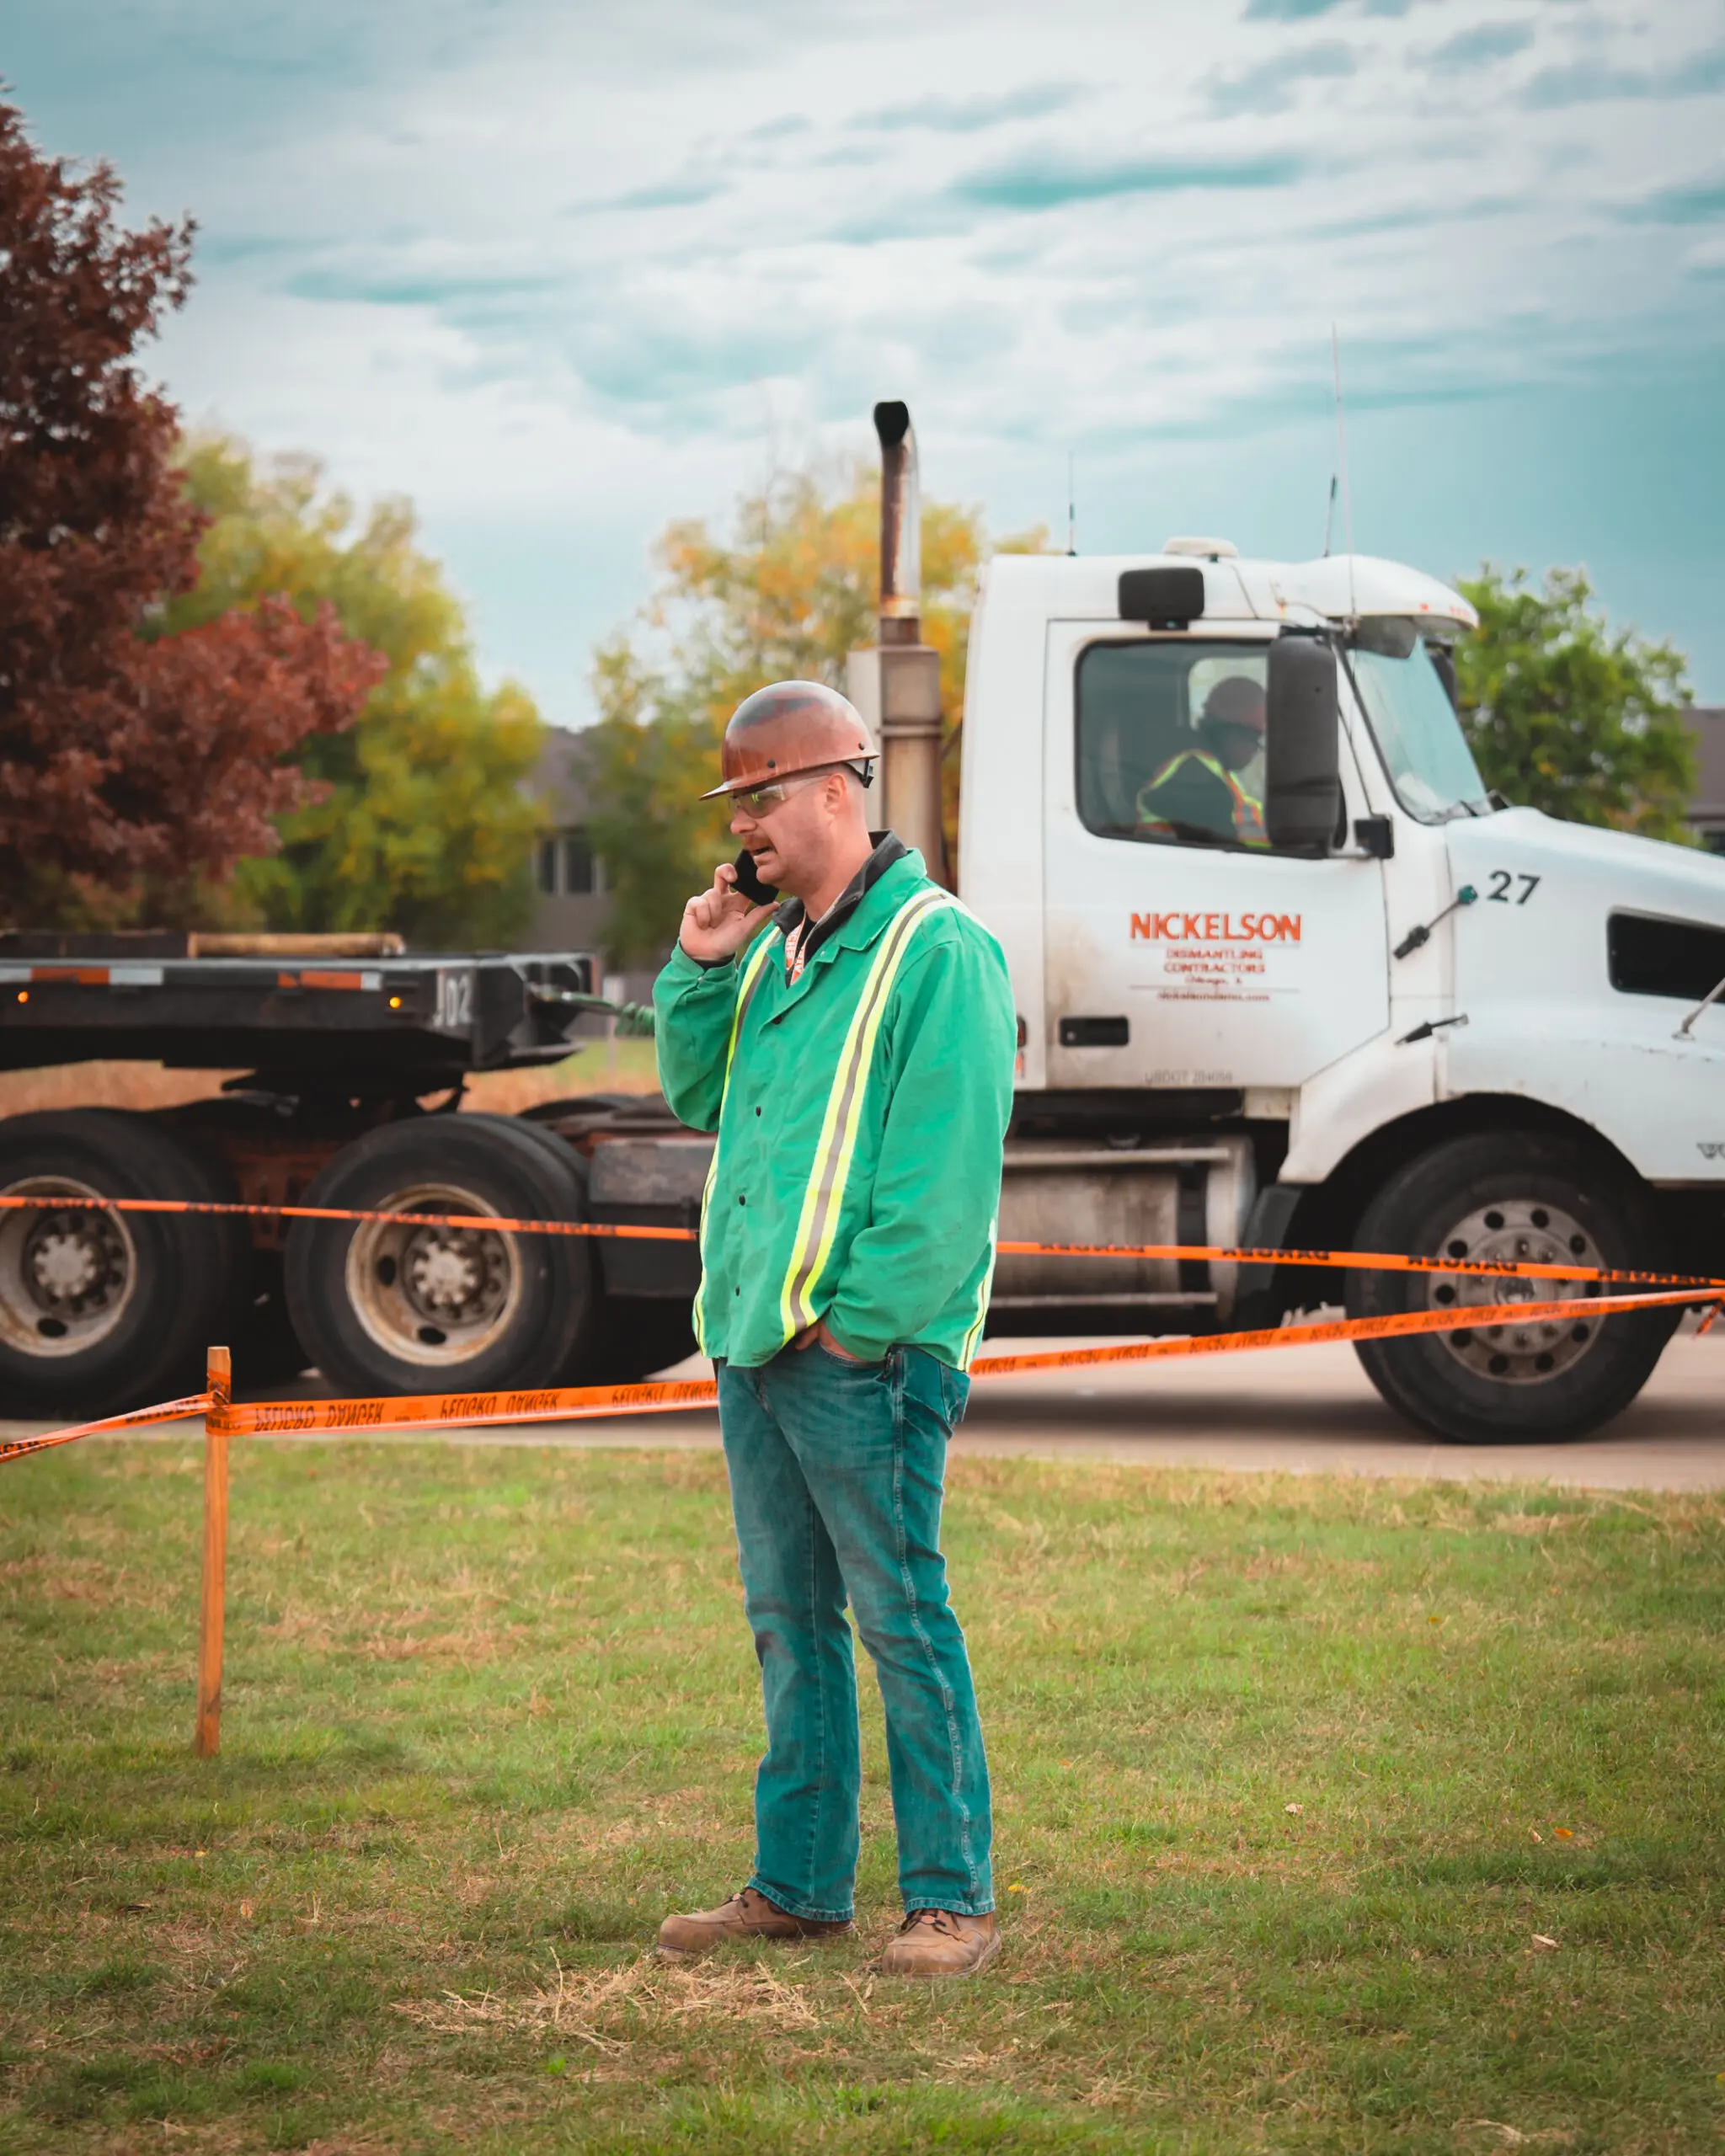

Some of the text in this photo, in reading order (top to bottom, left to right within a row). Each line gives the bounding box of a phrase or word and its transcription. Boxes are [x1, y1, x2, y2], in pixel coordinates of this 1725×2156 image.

[1487, 871, 1541, 905] 27
[1130, 912, 1302, 942] NICKELSON
[1167, 948, 1263, 959] DISMANTLING
[1164, 963, 1265, 973] CONTRACTORS
